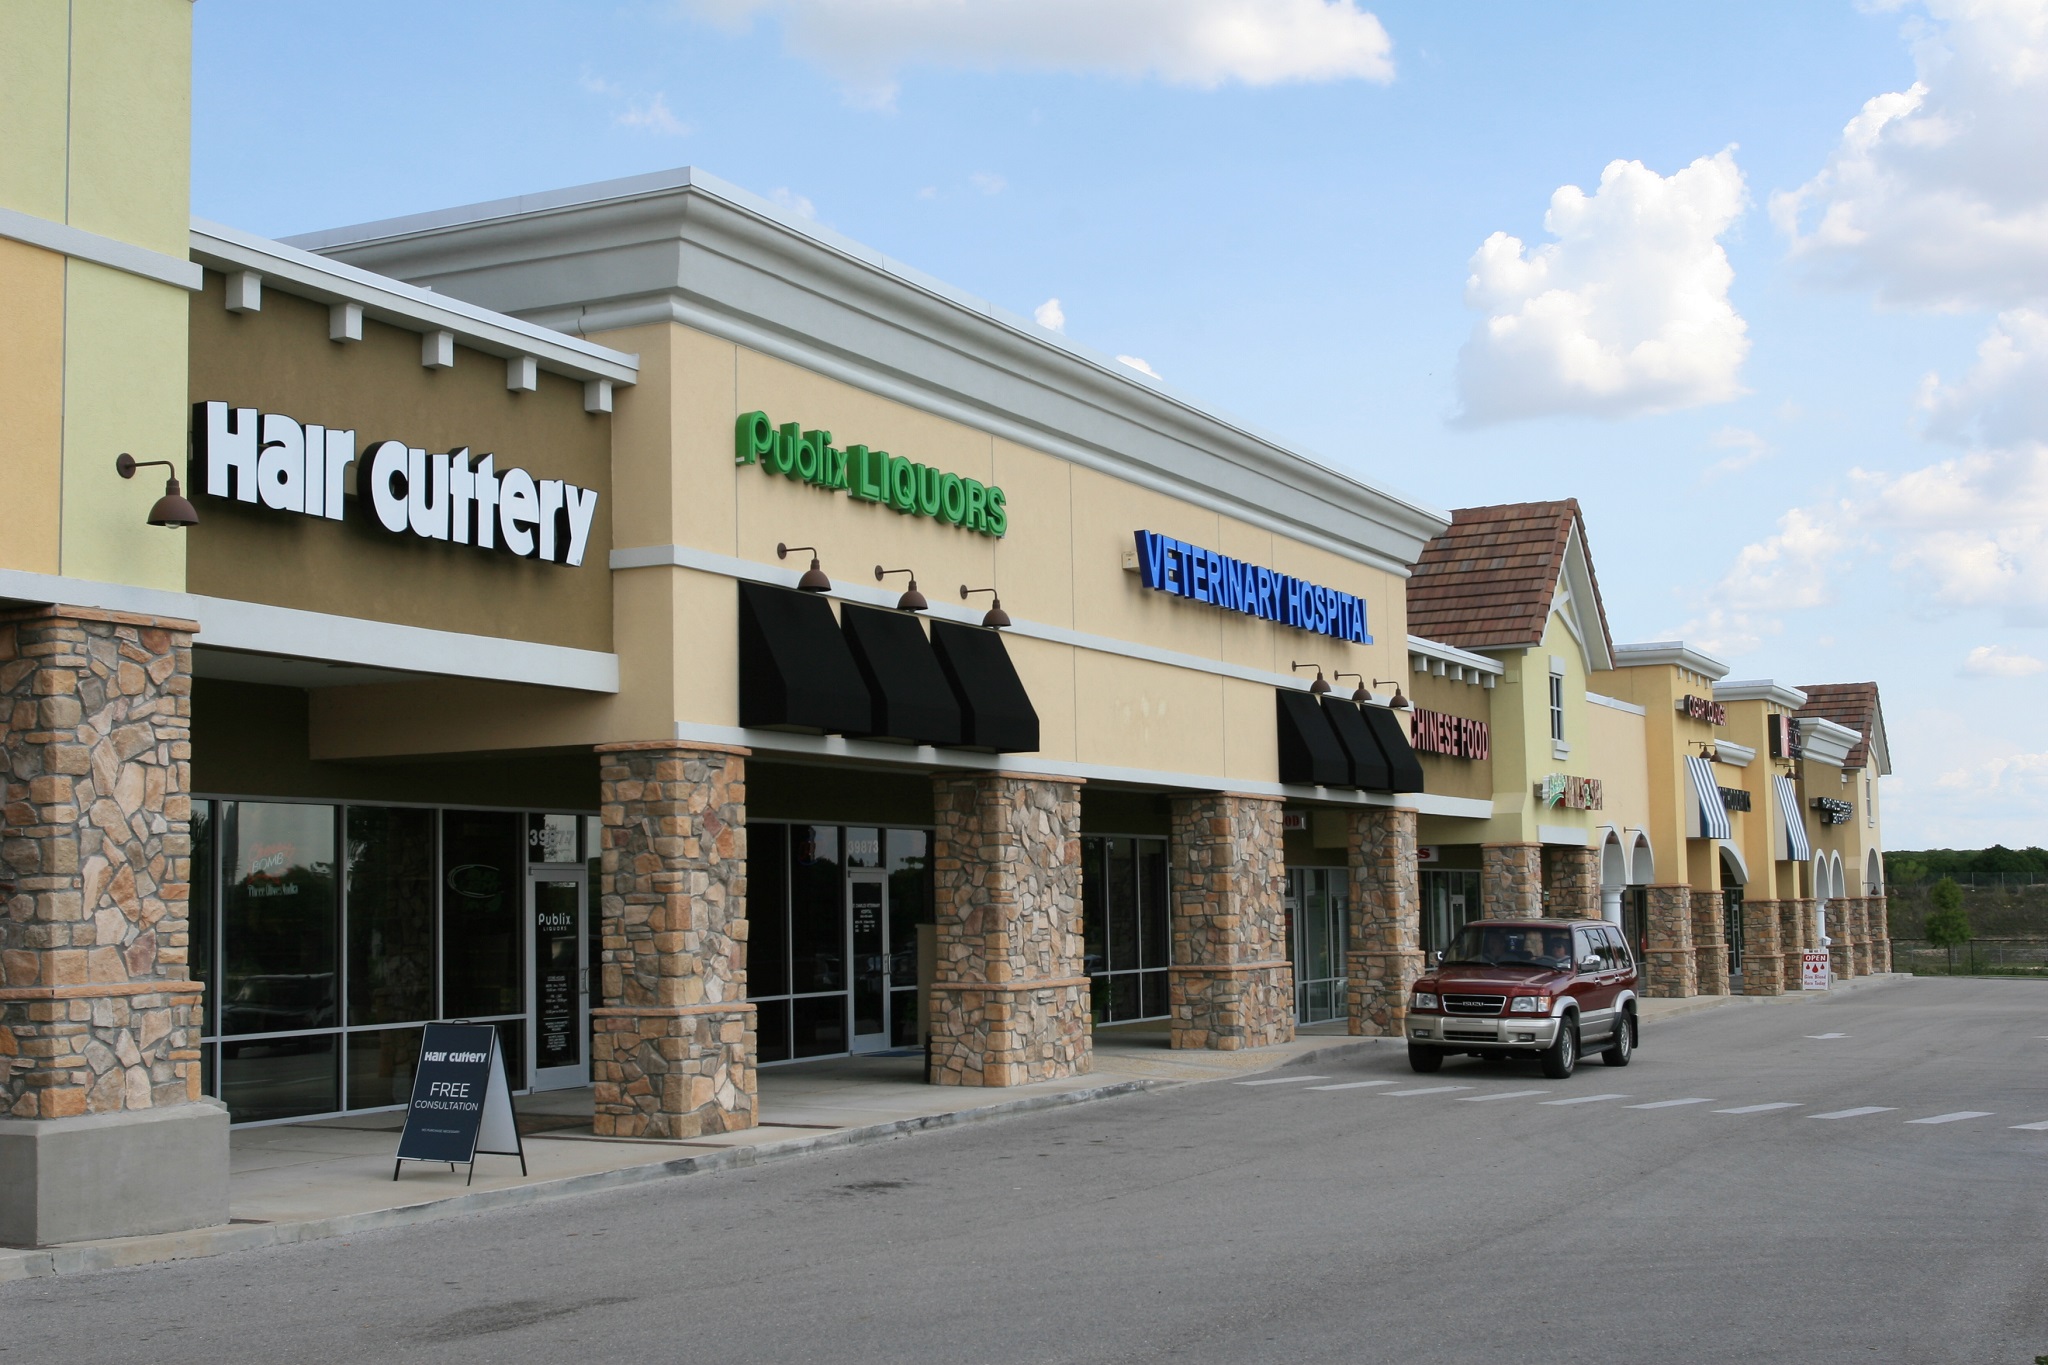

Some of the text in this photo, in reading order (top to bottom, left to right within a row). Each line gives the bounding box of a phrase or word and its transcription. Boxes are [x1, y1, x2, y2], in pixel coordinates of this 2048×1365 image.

[197, 400, 357, 522] Hair
[736, 410, 1008, 538] Publix LIQUORS
[1134, 529, 1374, 646] VETERINARY HOSPITAL
[1410, 707, 1490, 761] CHINESE FOOD
[848, 840, 879, 854] 39873
[538, 912, 571, 925] Publix
[424, 1051, 447, 1062] Hair
[429, 1082, 471, 1098] FREE
[414, 1100, 479, 1111] CONSULTATION
